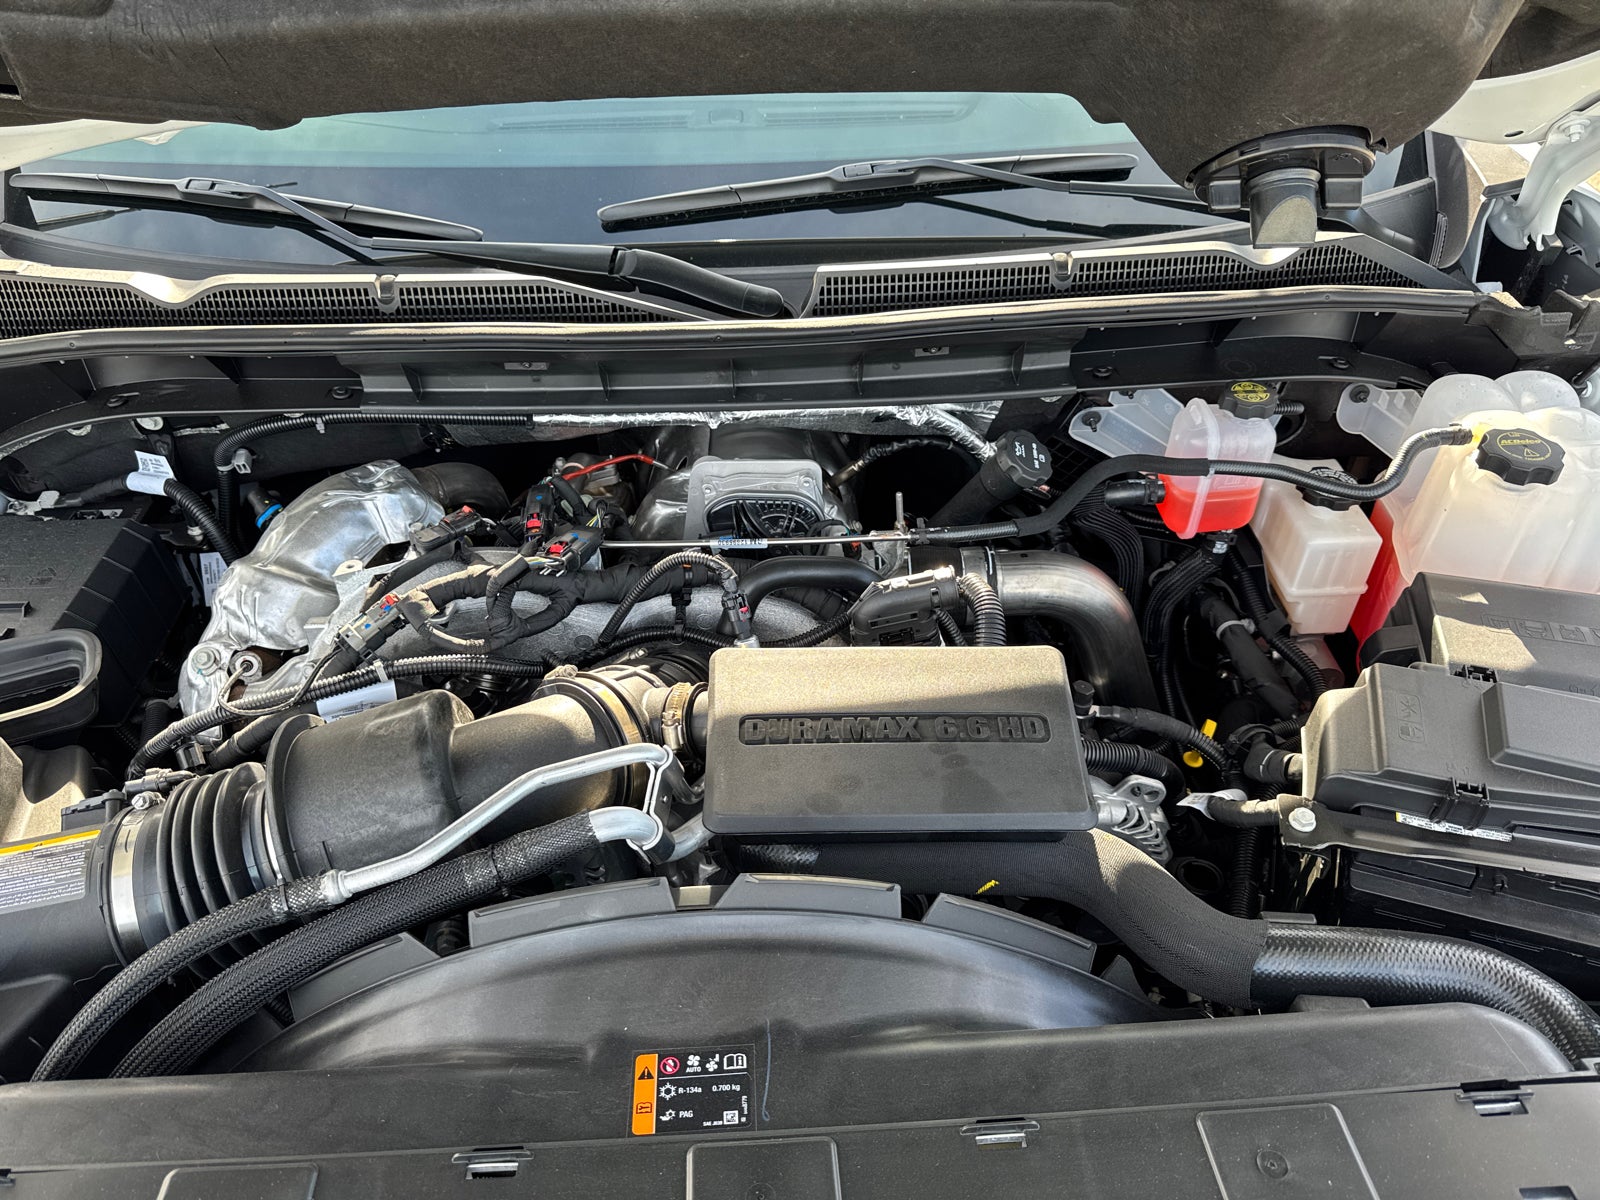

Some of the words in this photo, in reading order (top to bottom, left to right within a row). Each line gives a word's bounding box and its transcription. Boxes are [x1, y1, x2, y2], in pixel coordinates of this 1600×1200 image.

[744, 716, 920, 742] DURAMAX
[934, 716, 991, 740] 6.6
[997, 716, 1047, 740] HD
[731, 1083, 741, 1092] kg
[679, 1110, 694, 1118] PAG
